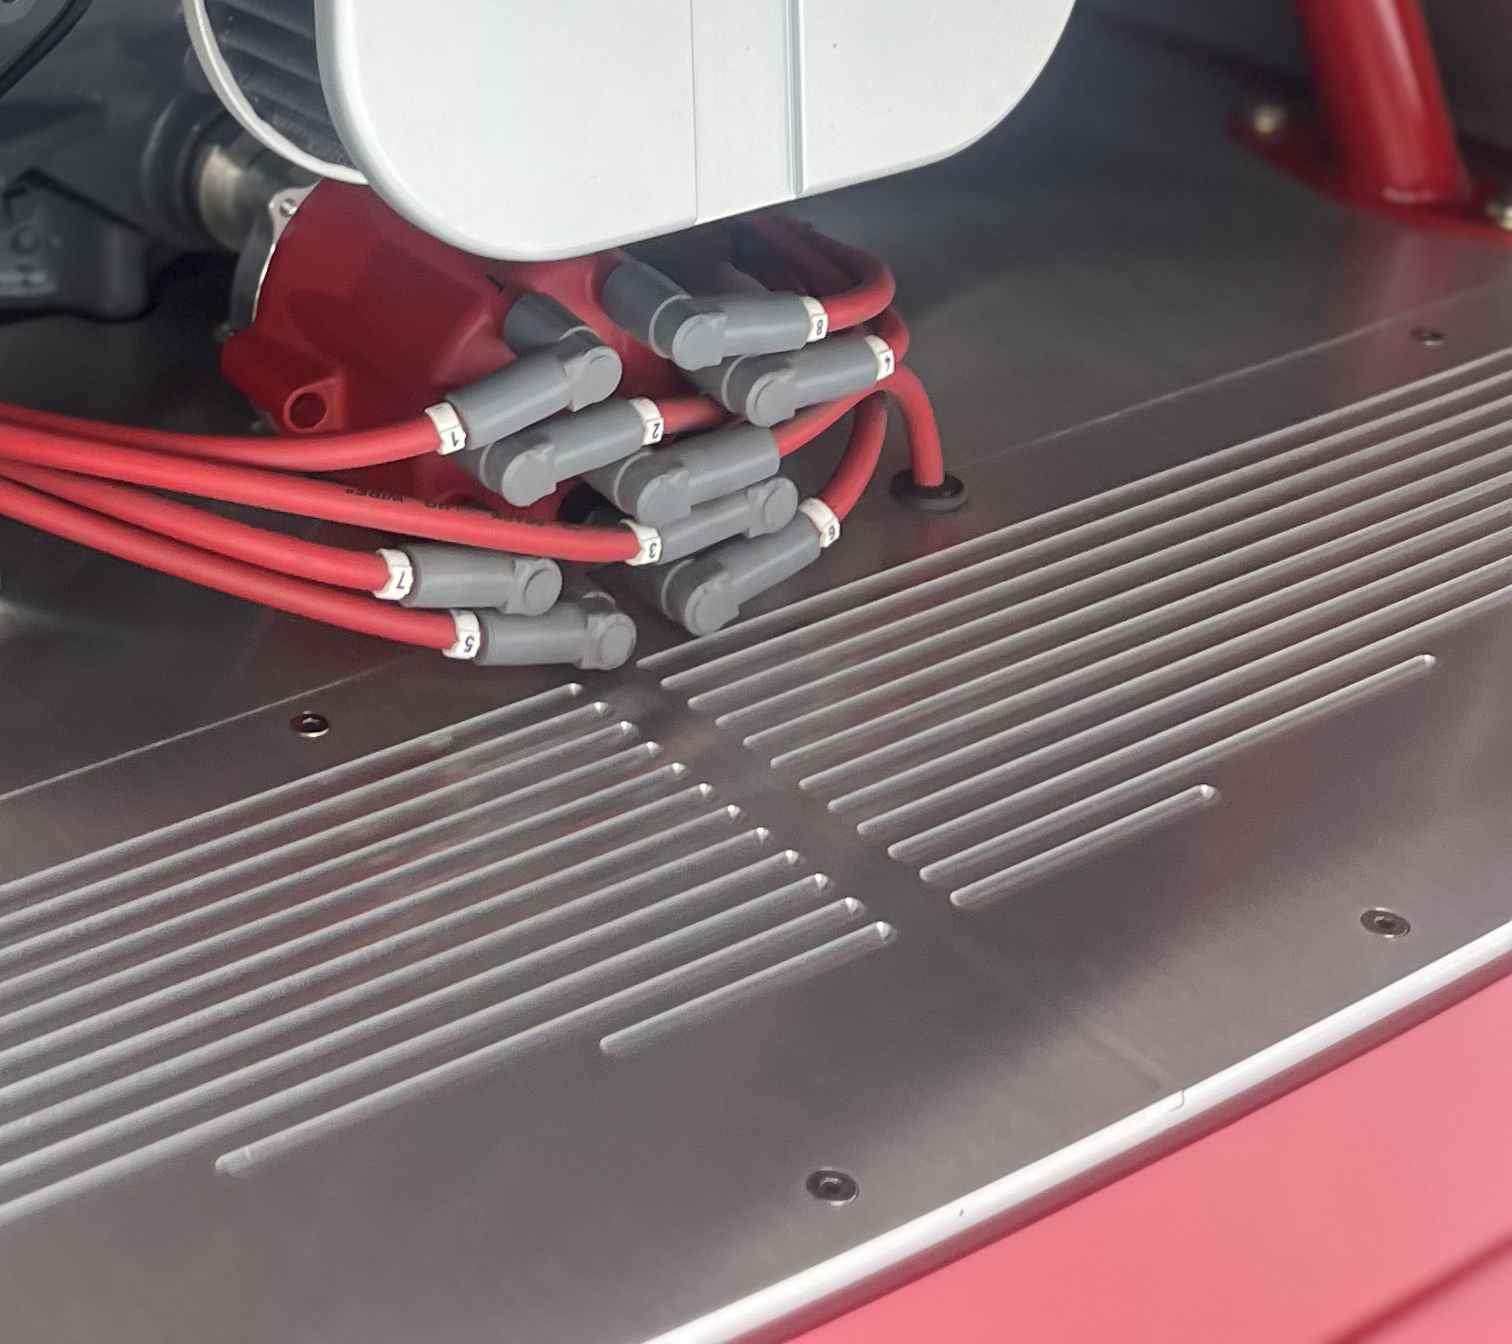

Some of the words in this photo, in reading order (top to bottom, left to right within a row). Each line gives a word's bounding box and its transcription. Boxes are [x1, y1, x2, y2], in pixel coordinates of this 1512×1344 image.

[816, 318, 824, 336] 8
[451, 431, 460, 447] 1
[651, 422, 661, 439] 2
[648, 542, 657, 559] 3
[396, 570, 405, 590] 7
[463, 634, 475, 654] 5
